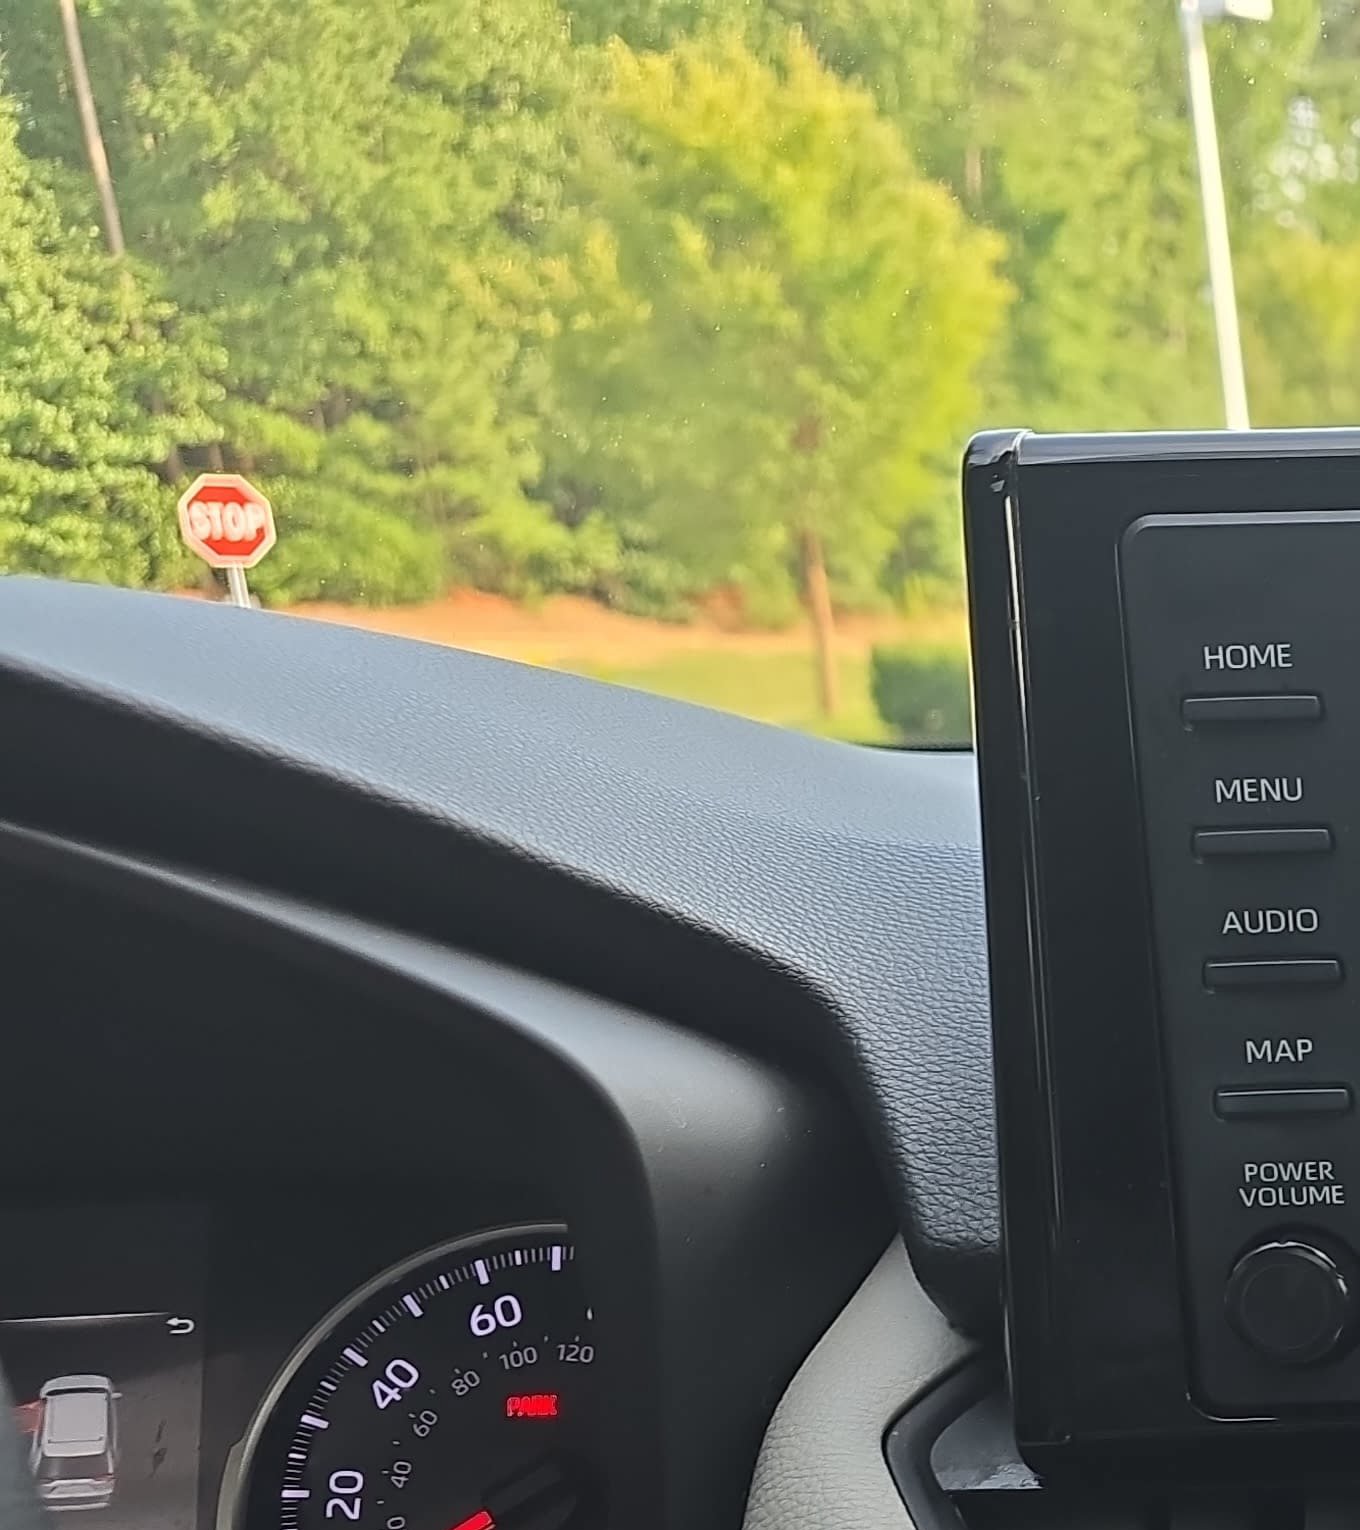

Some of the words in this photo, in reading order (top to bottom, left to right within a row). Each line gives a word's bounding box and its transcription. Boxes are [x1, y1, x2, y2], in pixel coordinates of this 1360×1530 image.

[189, 500, 266, 543] STOP
[1203, 643, 1293, 670] HOME
[1215, 777, 1302, 803] MENU
[1222, 908, 1318, 934] AUDIO
[1246, 1038, 1313, 1064] MAP
[1244, 1161, 1335, 1183] POWER
[1238, 1184, 1345, 1207] VOLUME
[470, 1295, 522, 1337] 60
[499, 1346, 538, 1370] 100
[557, 1344, 594, 1363] 120
[372, 1359, 419, 1409] 40
[451, 1371, 480, 1397] 80
[413, 1410, 438, 1438] 60
[390, 1461, 412, 1489] 40
[326, 1470, 364, 1520] 20
